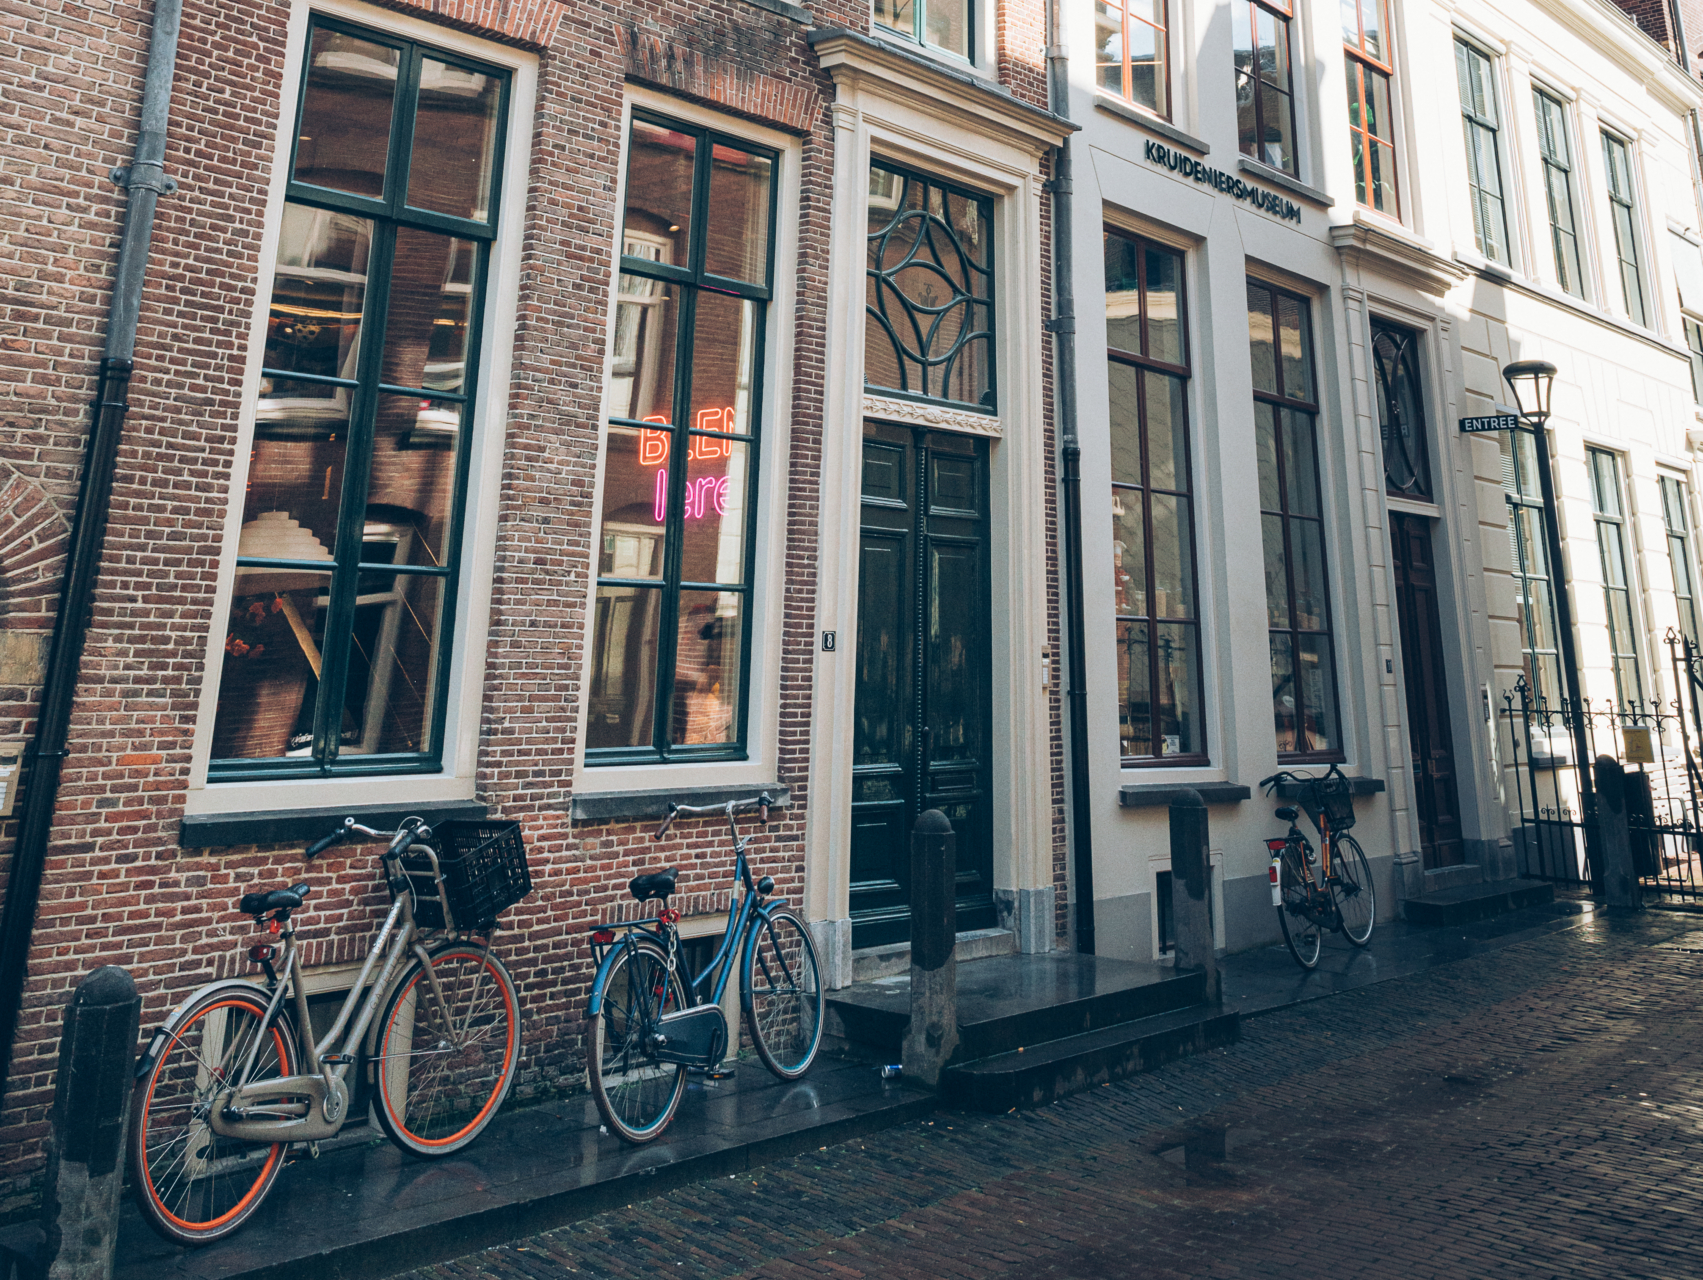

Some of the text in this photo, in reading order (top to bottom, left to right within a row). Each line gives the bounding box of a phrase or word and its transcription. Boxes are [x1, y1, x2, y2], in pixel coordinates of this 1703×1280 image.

[1145, 139, 1302, 225] KRUIDENIERSMUSEUM
[1464, 416, 1516, 431] ENTREE
[827, 634, 833, 648] 8
